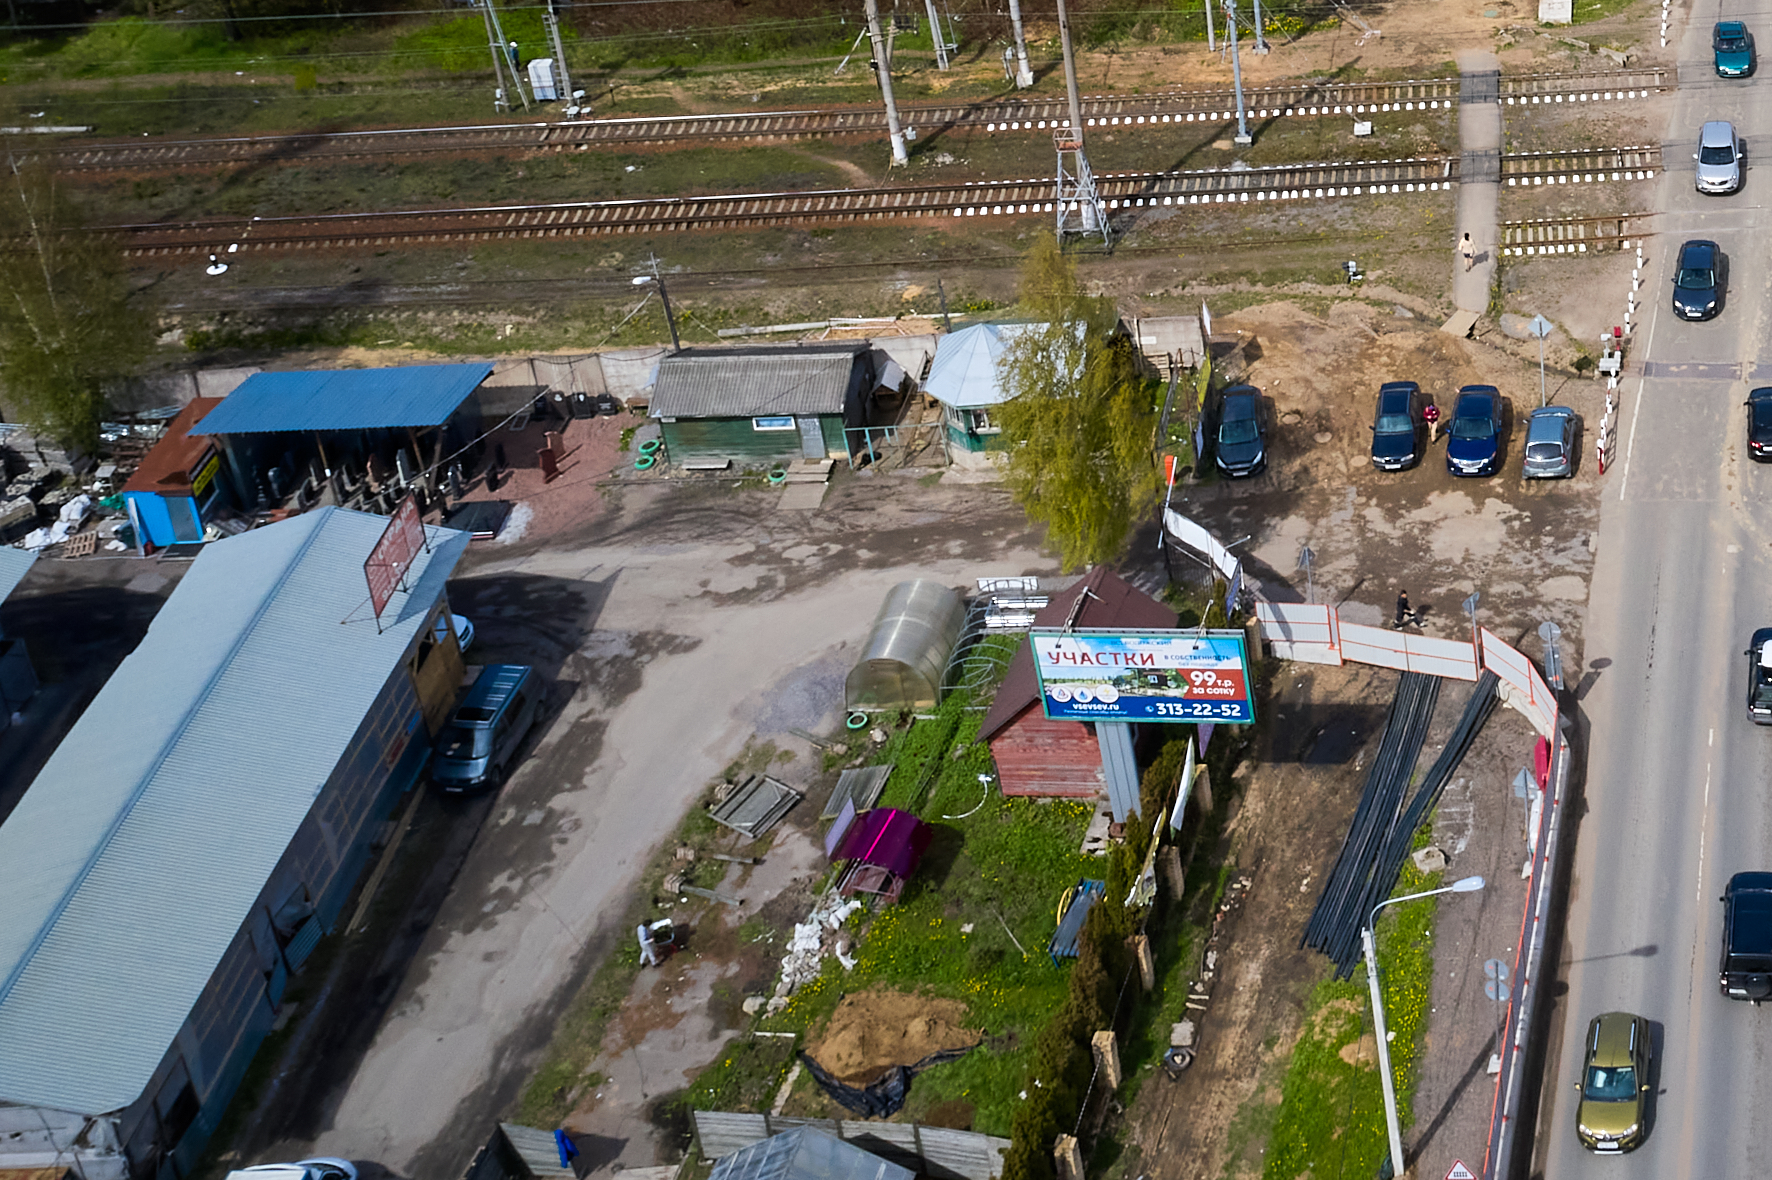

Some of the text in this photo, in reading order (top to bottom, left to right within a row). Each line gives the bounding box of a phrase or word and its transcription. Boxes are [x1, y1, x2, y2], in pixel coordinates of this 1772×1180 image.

[1047, 651, 1155, 666] УЧАСТКИ
[1190, 671, 1217, 686] 99
[1206, 687, 1235, 696] сотку
[1072, 703, 1120, 711] vsevsev.ru
[1155, 703, 1241, 716] 313-22-52
